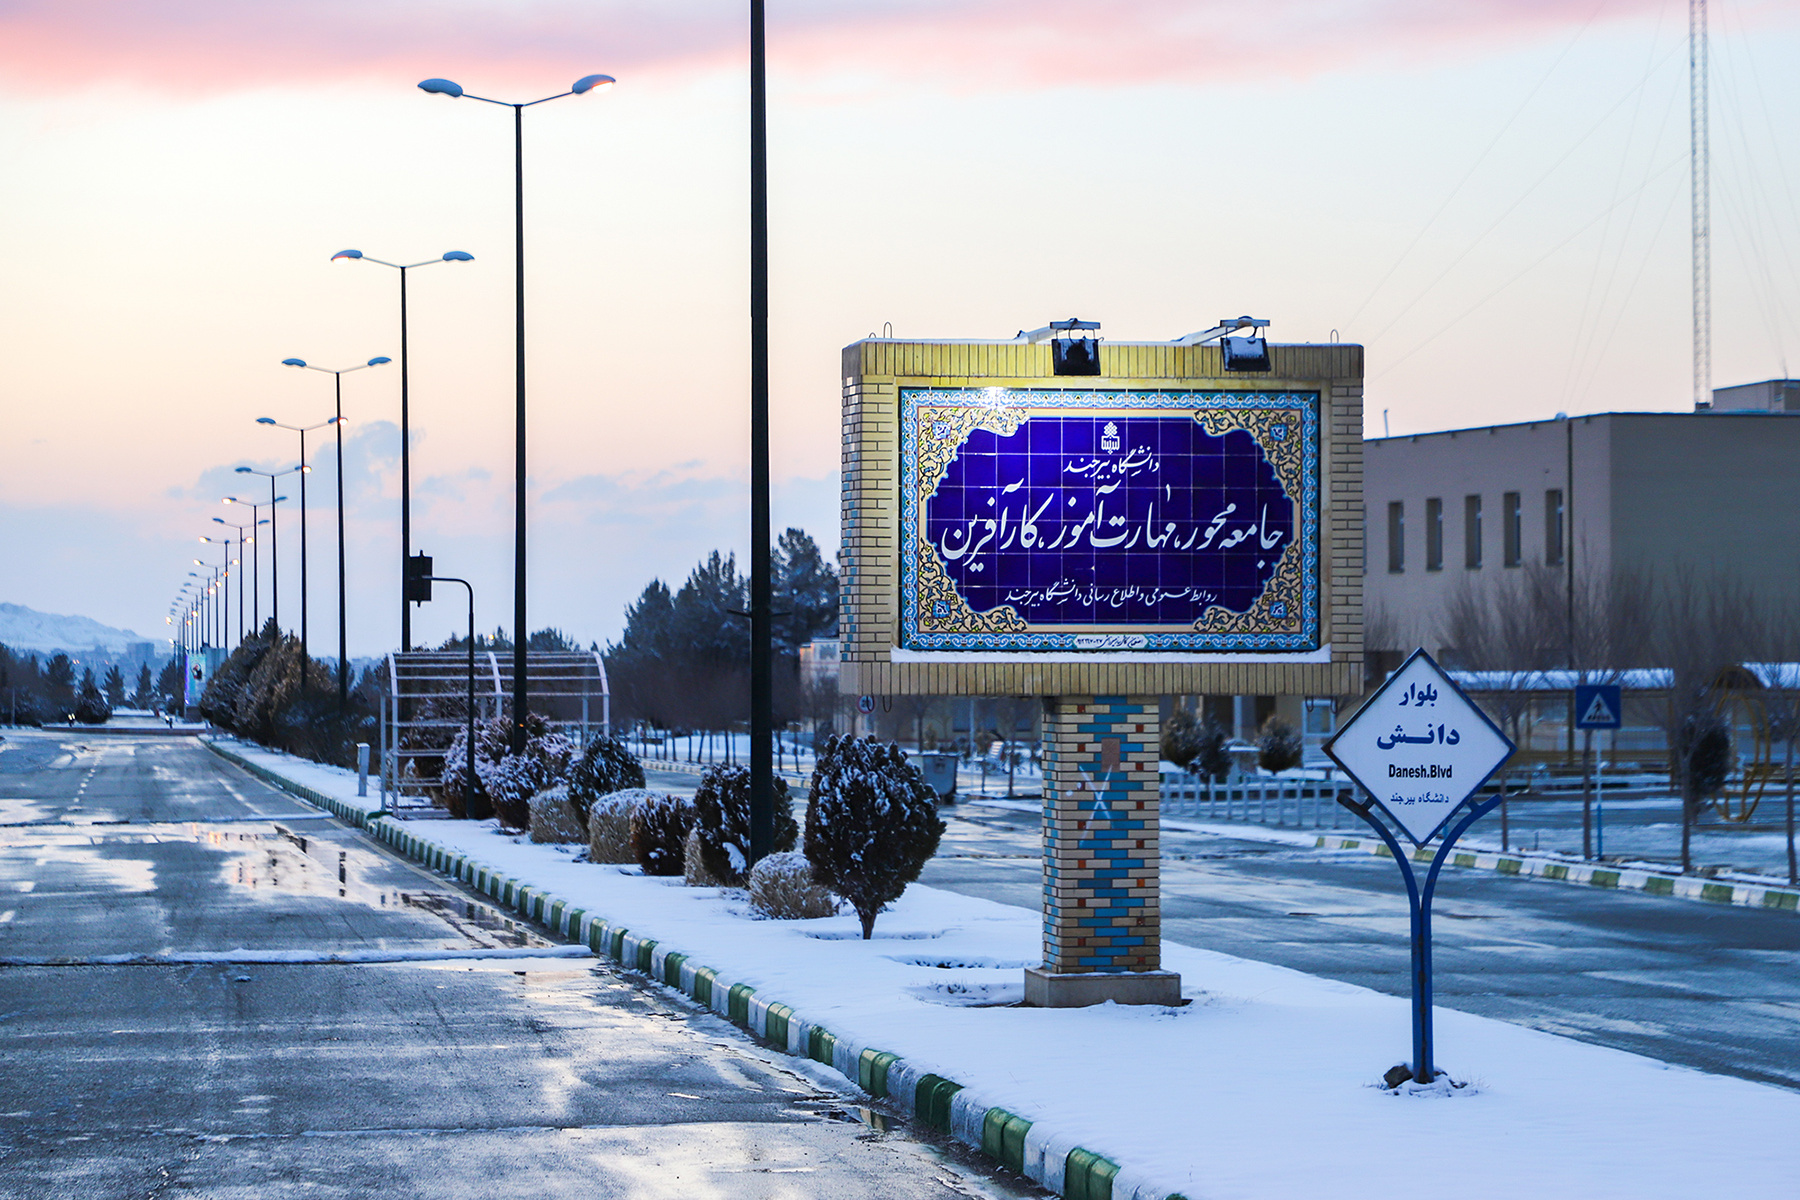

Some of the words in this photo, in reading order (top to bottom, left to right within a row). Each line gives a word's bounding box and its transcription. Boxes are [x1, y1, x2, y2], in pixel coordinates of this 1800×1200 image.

[1063, 457, 1111, 480] بیرجند
[1111, 445, 1160, 477] دانشگاه
[941, 477, 1055, 573] کارآفرین
[1090, 499, 1177, 549] مهارت
[1218, 502, 1284, 570] جامعه
[1004, 588, 1040, 607] بیرجند
[1039, 577, 1082, 605] دانشگاه
[1082, 582, 1111, 607] رسانی
[1145, 586, 1192, 607] عمومی
[1189, 588, 1218, 606] روابط
[1398, 682, 1438, 707] بلوار
[1376, 723, 1461, 750] دانش
[1388, 764, 1453, 778] Danesh.Blvd
[1390, 792, 1416, 805] بیرجند
